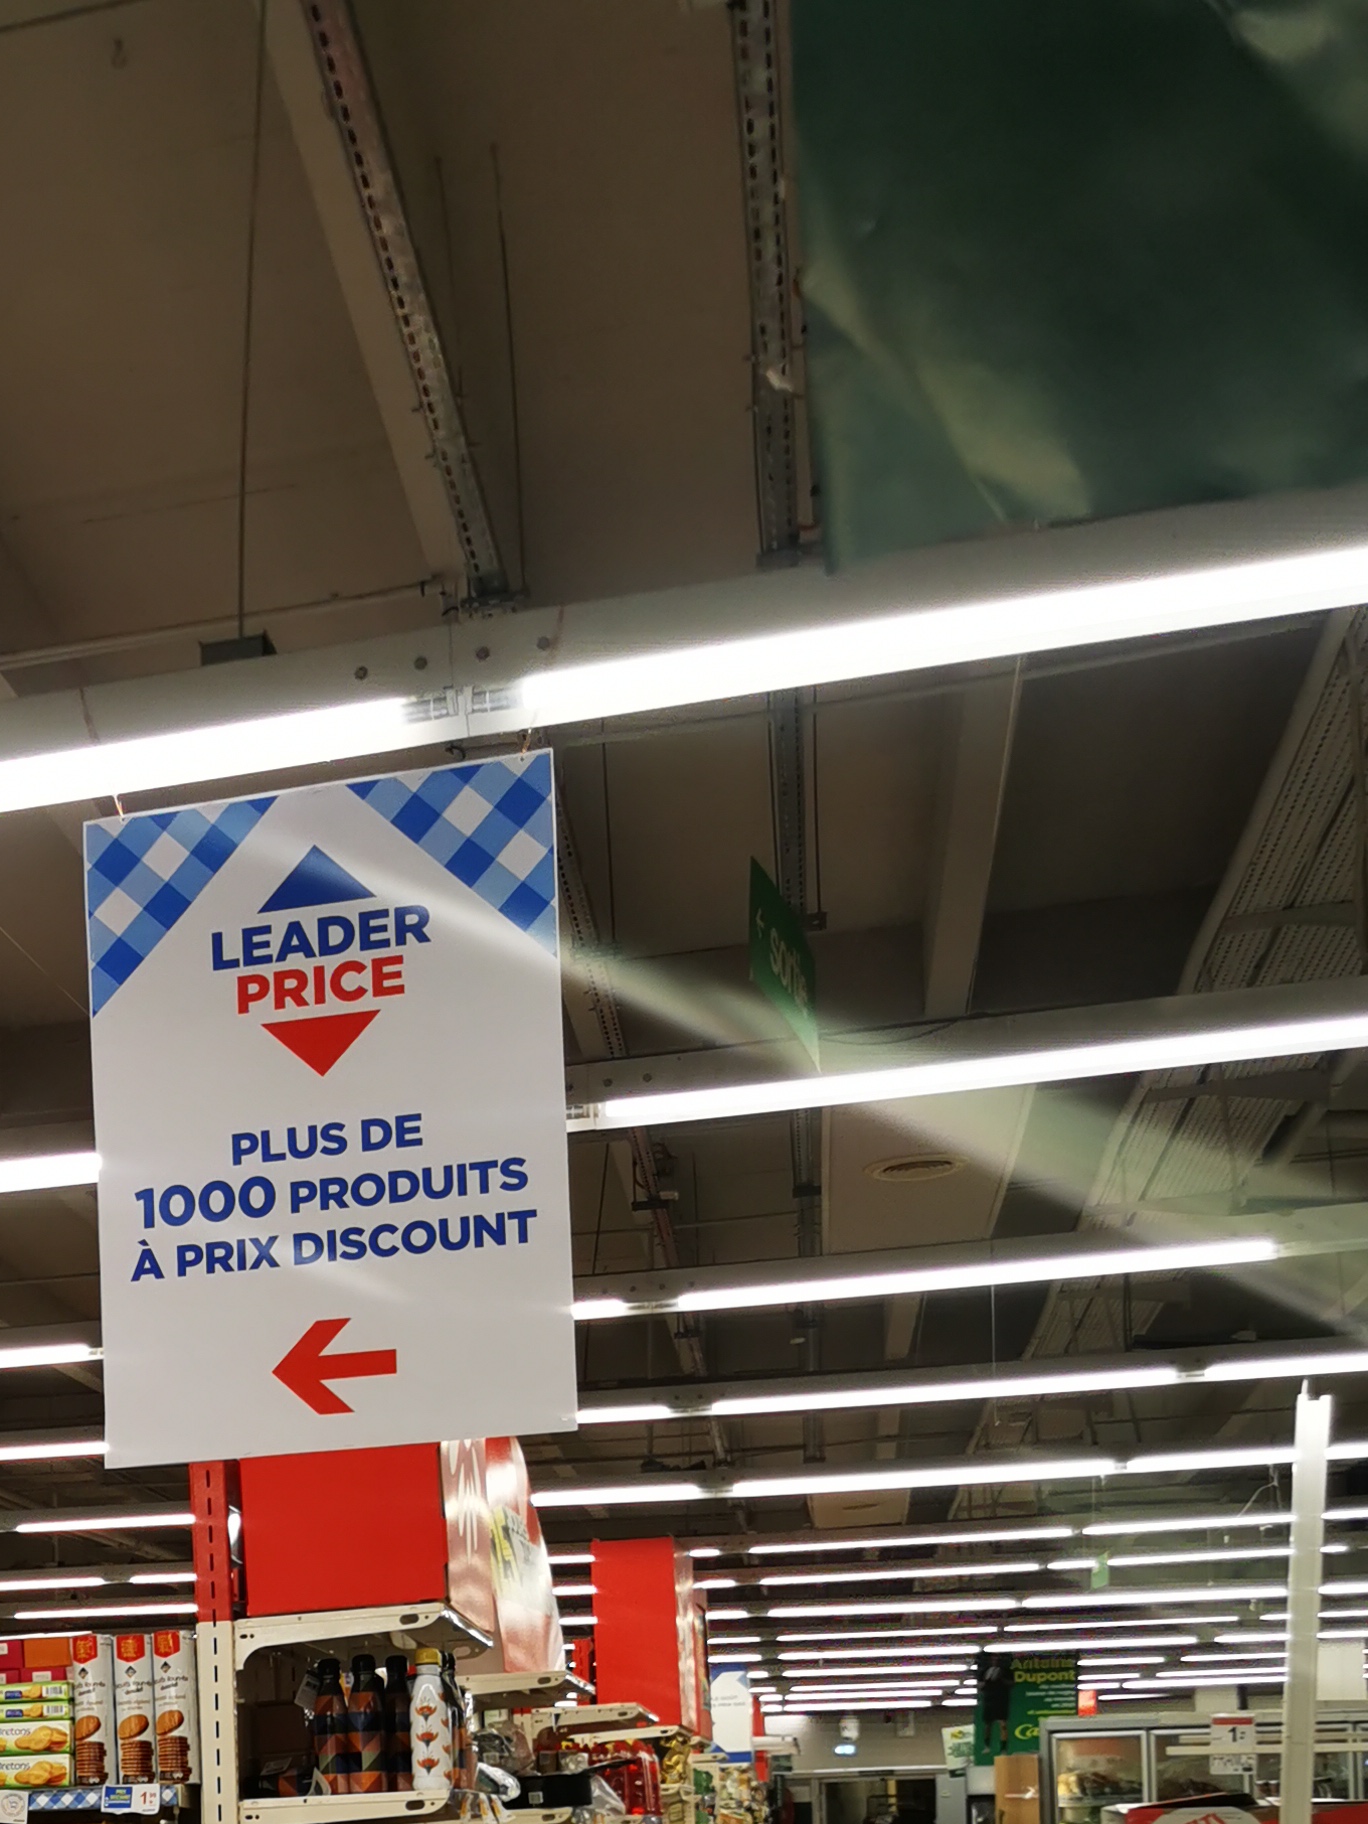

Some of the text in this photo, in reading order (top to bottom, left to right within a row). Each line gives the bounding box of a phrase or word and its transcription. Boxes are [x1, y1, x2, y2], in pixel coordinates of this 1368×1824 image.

[211, 905, 431, 971] LEADER
[237, 954, 405, 1015] PRICE
[231, 1112, 423, 1167] PLUS DE
[134, 1156, 529, 1230] 1000 PRODUITS
[131, 1209, 538, 1282] À PRIX DISCOUNT
[1014, 1670, 1075, 1684] Dupont
